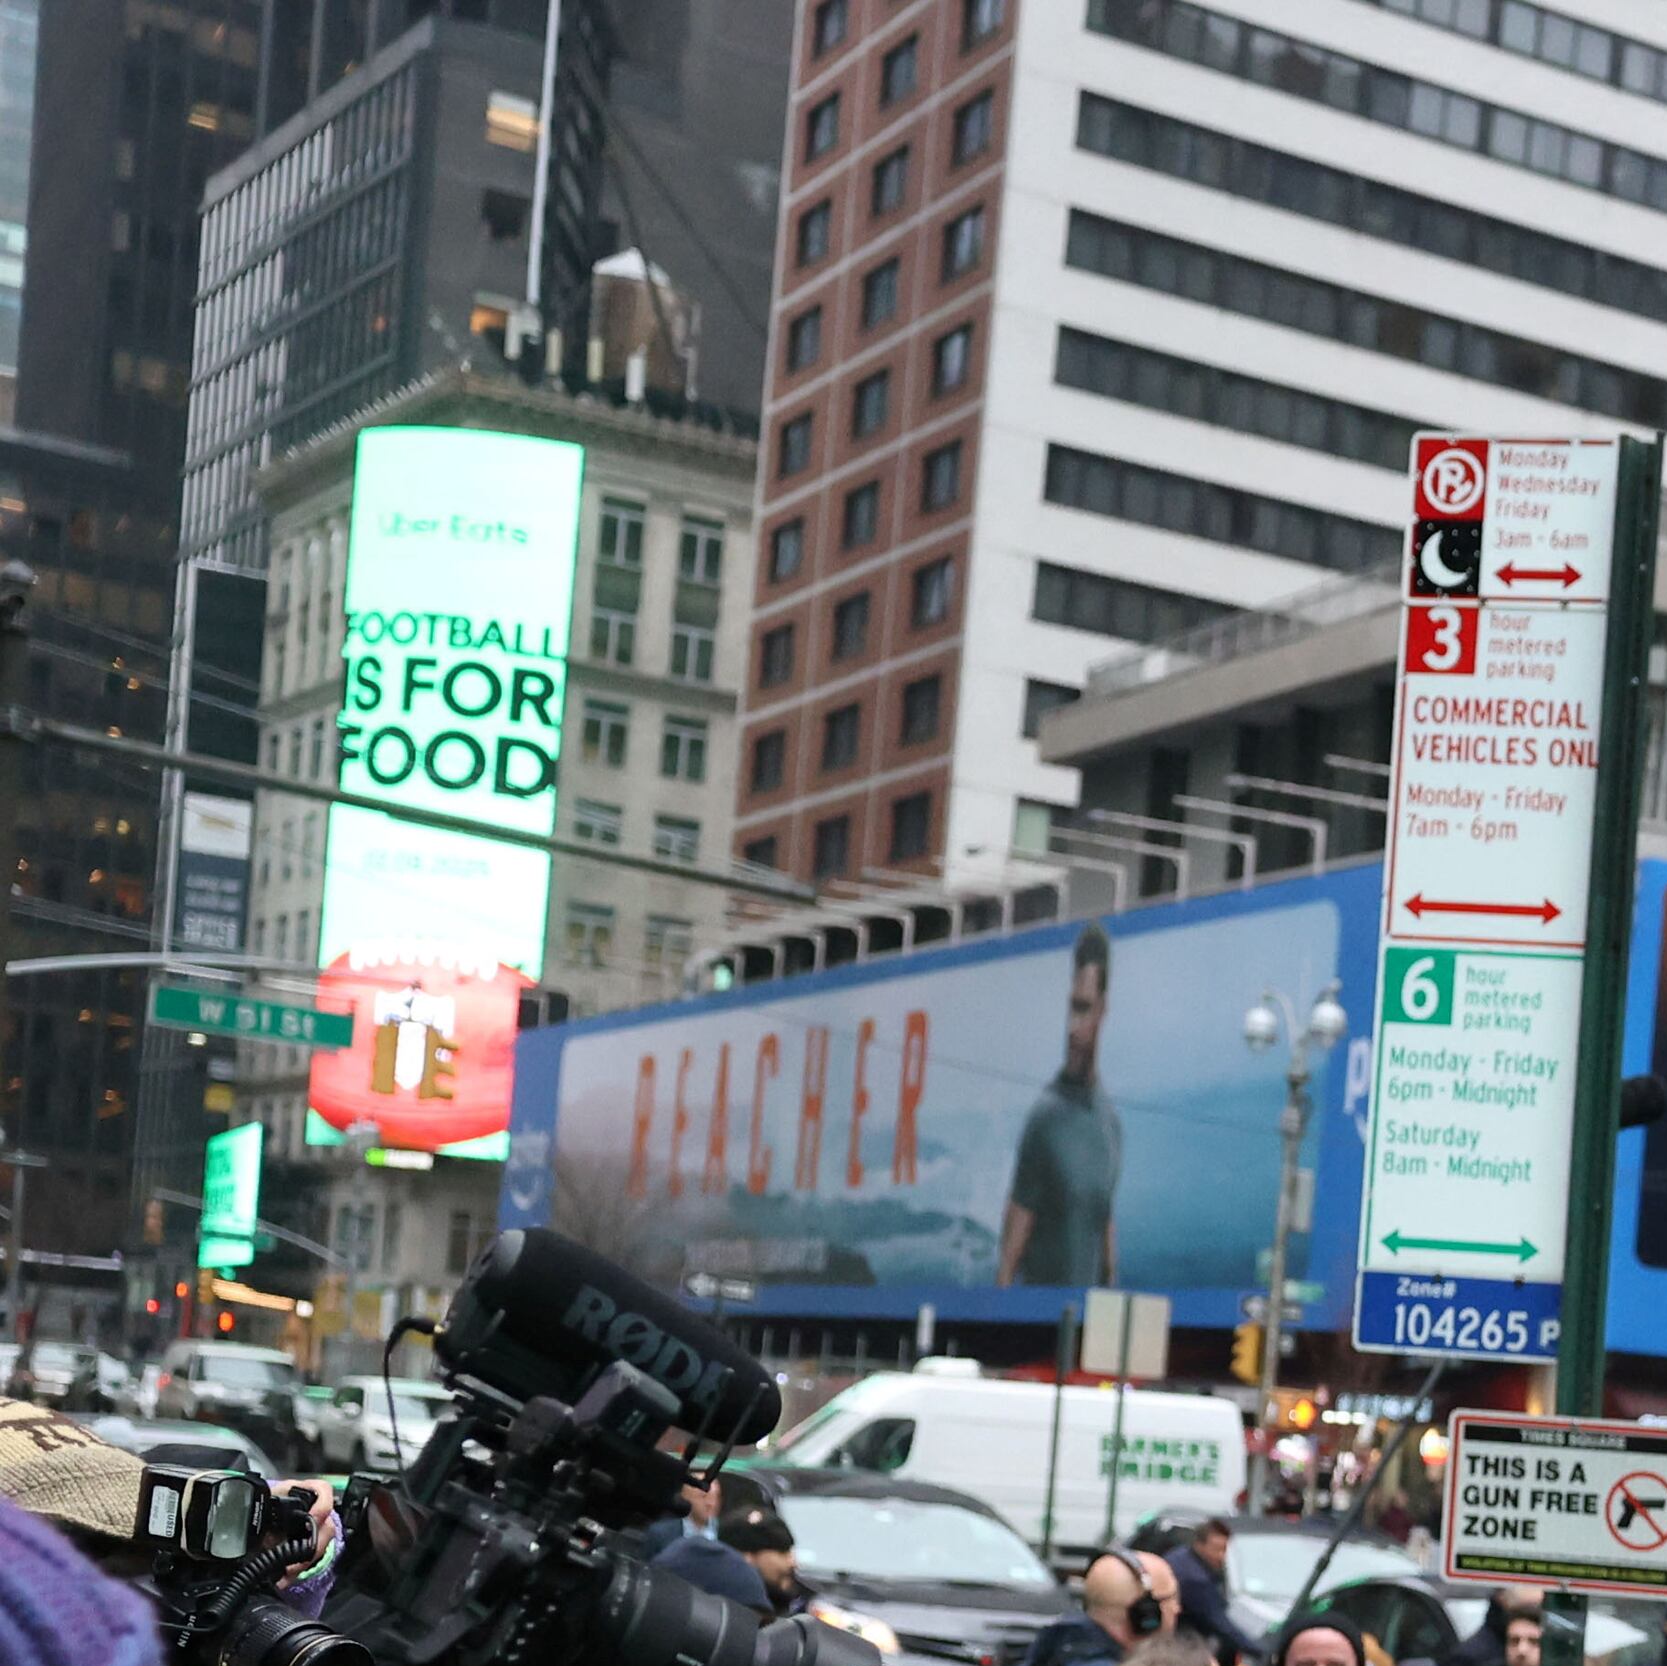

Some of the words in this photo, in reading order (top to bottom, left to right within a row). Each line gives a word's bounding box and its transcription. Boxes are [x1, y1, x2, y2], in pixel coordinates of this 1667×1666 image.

[1499, 450, 1570, 471] Monday
[1498, 474, 1600, 496] Wednesday
[1496, 499, 1549, 520] Friday
[381, 513, 440, 538] Uber
[450, 514, 528, 544] Eats
[1496, 529, 1532, 546] 3am
[1550, 530, 1589, 549] 6am
[1490, 612, 1530, 631] hour
[1422, 607, 1462, 671] 3
[1488, 637, 1567, 656] metered
[1487, 662, 1555, 682] parking
[403, 656, 555, 726] FOR
[1413, 696, 1588, 730] COMMERCIAL
[1412, 734, 1538, 765] VEHICLES
[1549, 738, 1600, 769] ONL
[1407, 783, 1484, 811] Monday
[1504, 785, 1568, 813] Friday
[1406, 814, 1448, 838] 7am
[1471, 816, 1518, 842] 6pm
[1401, 956, 1440, 1021] 6
[1465, 965, 1506, 984] hour
[1464, 990, 1543, 1010] metered
[1462, 1011, 1532, 1036] parking
[1389, 1045, 1472, 1075] Monday
[1493, 1050, 1559, 1080] Friday
[624, 1010, 929, 1198] REACHER
[1387, 1077, 1433, 1101] 6pm
[1452, 1079, 1538, 1109] Midnight
[1385, 1119, 1481, 1151] Saturday
[1381, 1152, 1427, 1175] 8am
[1447, 1155, 1532, 1184] Midnight
[1393, 1303, 1528, 1352] 104265
[1465, 1455, 1525, 1478] THIS
[1536, 1459, 1560, 1481] IS
[1569, 1462, 1587, 1484] A
[1463, 1485, 1519, 1509] GUN
[1530, 1489, 1598, 1514] FREE
[1463, 1516, 1537, 1541] ZONE
